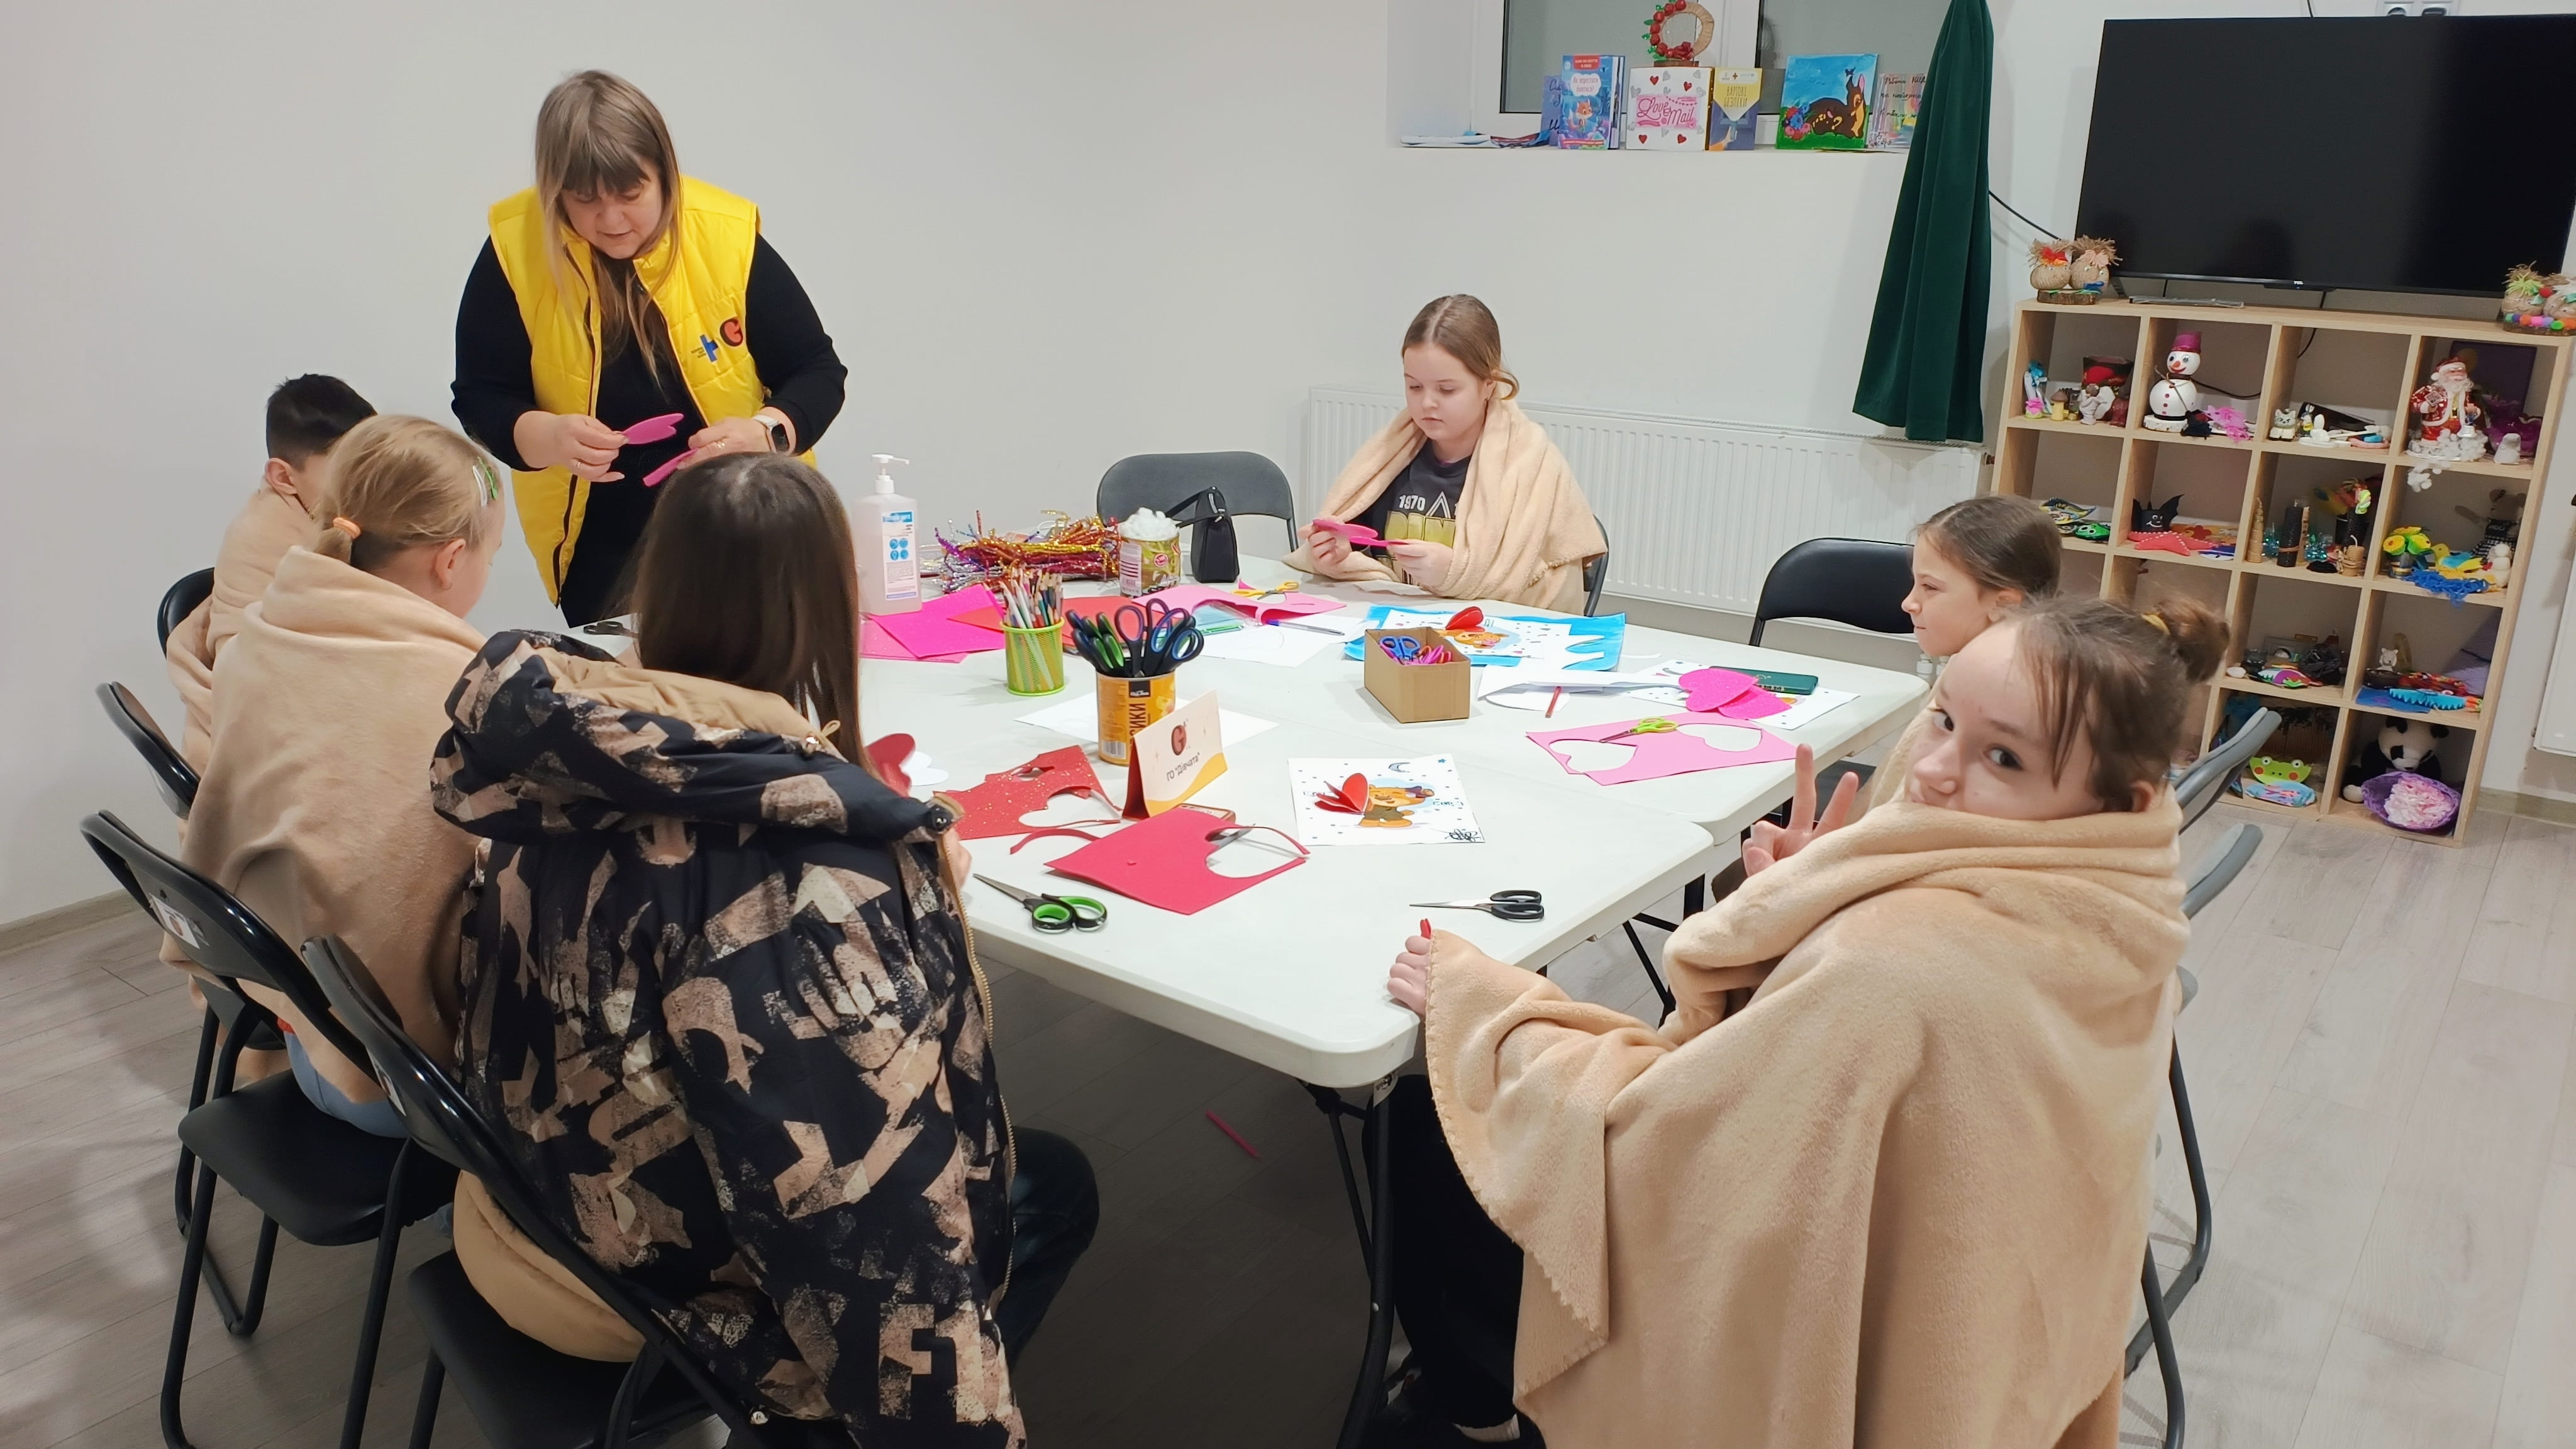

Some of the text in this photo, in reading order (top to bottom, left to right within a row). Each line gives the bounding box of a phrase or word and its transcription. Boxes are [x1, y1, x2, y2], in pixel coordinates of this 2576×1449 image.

[1636, 97, 1669, 120] Love
[1667, 106, 1694, 125] Mail
[1399, 494, 1426, 511] 1970
[1167, 770, 1175, 781] ГО
